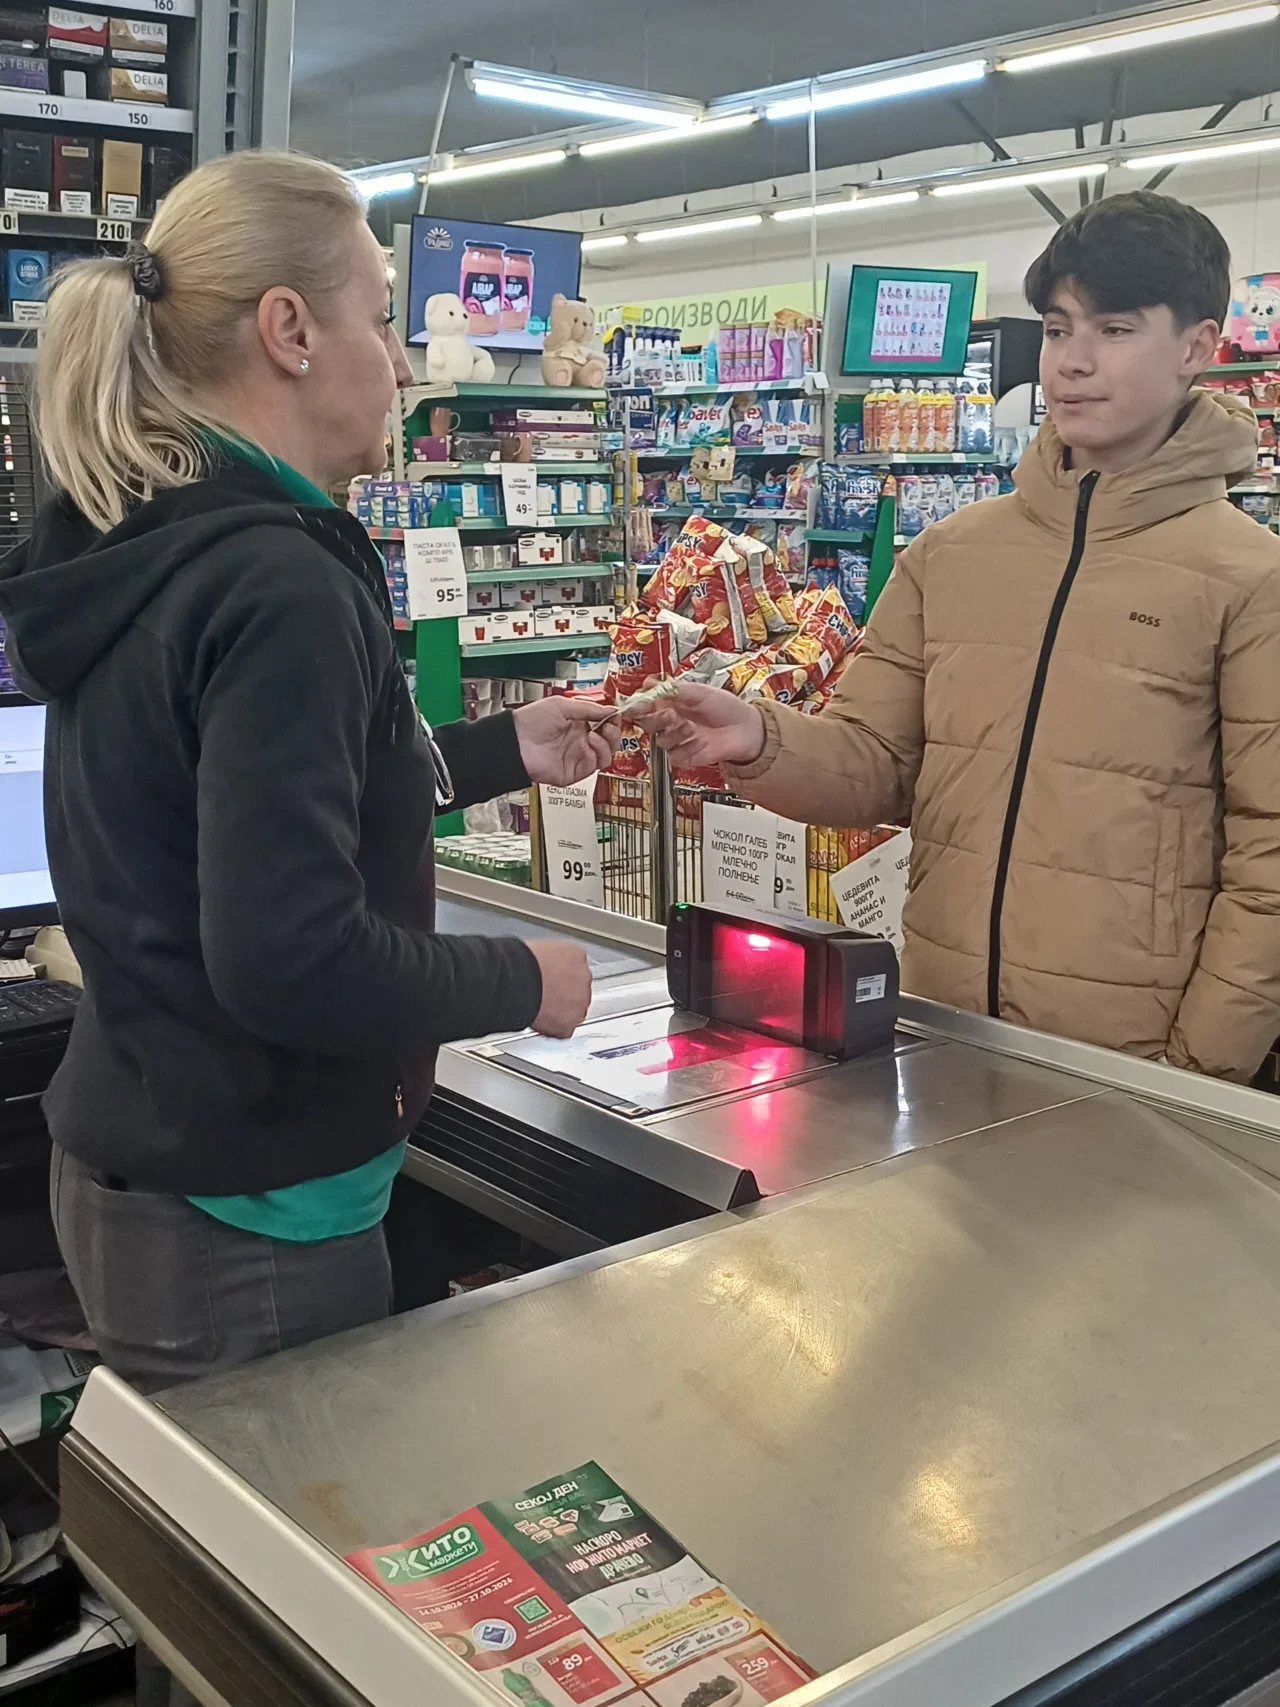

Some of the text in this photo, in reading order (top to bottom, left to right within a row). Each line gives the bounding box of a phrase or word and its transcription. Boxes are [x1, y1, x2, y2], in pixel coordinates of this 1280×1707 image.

[154, 0, 174, 11] 160
[132, 23, 165, 37] DELIA
[10, 58, 47, 72] TEREA
[133, 73, 165, 87] DELIA
[38, 102, 59, 116] 170
[128, 112, 149, 126] 150
[100, 222, 126, 240] 210
[642, 294, 768, 329] РОИЗВОДИ
[515, 503, 528, 515] 49
[436, 588, 455, 603] 95
[1128, 611, 1161, 628] BOSS
[562, 787, 588, 798] ПЛАЗМА
[564, 798, 586, 809] БАМБИ
[713, 828, 768, 849] ЧОКОЛ ГАЛЕБ
[711, 840, 769, 861] МЛЕЧНО 100ГР
[562, 859, 584, 881] 99
[722, 855, 758, 871] МЛЕЧНО
[718, 866, 760, 885] ПОЛНЕЊЕ
[841, 875, 881, 902] ЦЕДЕВИТА
[853, 889, 875, 908] 900ГР
[850, 895, 887, 922] АНАНАС И
[858, 910, 884, 930] МАНГО
[514, 1480, 579, 1511] СЕКОЈ ДЕН
[572, 1529, 623, 1556] НАСКОРО
[379, 1526, 472, 1579] ЖИТО
[565, 1558, 589, 1575] НОВ
[584, 1547, 617, 1567] ЖИТО
[611, 1532, 653, 1557] МАРКЕТ
[599, 1552, 645, 1581] ДРАЧЕВО
[562, 1653, 584, 1671] 89
[741, 1656, 770, 1676] 259
